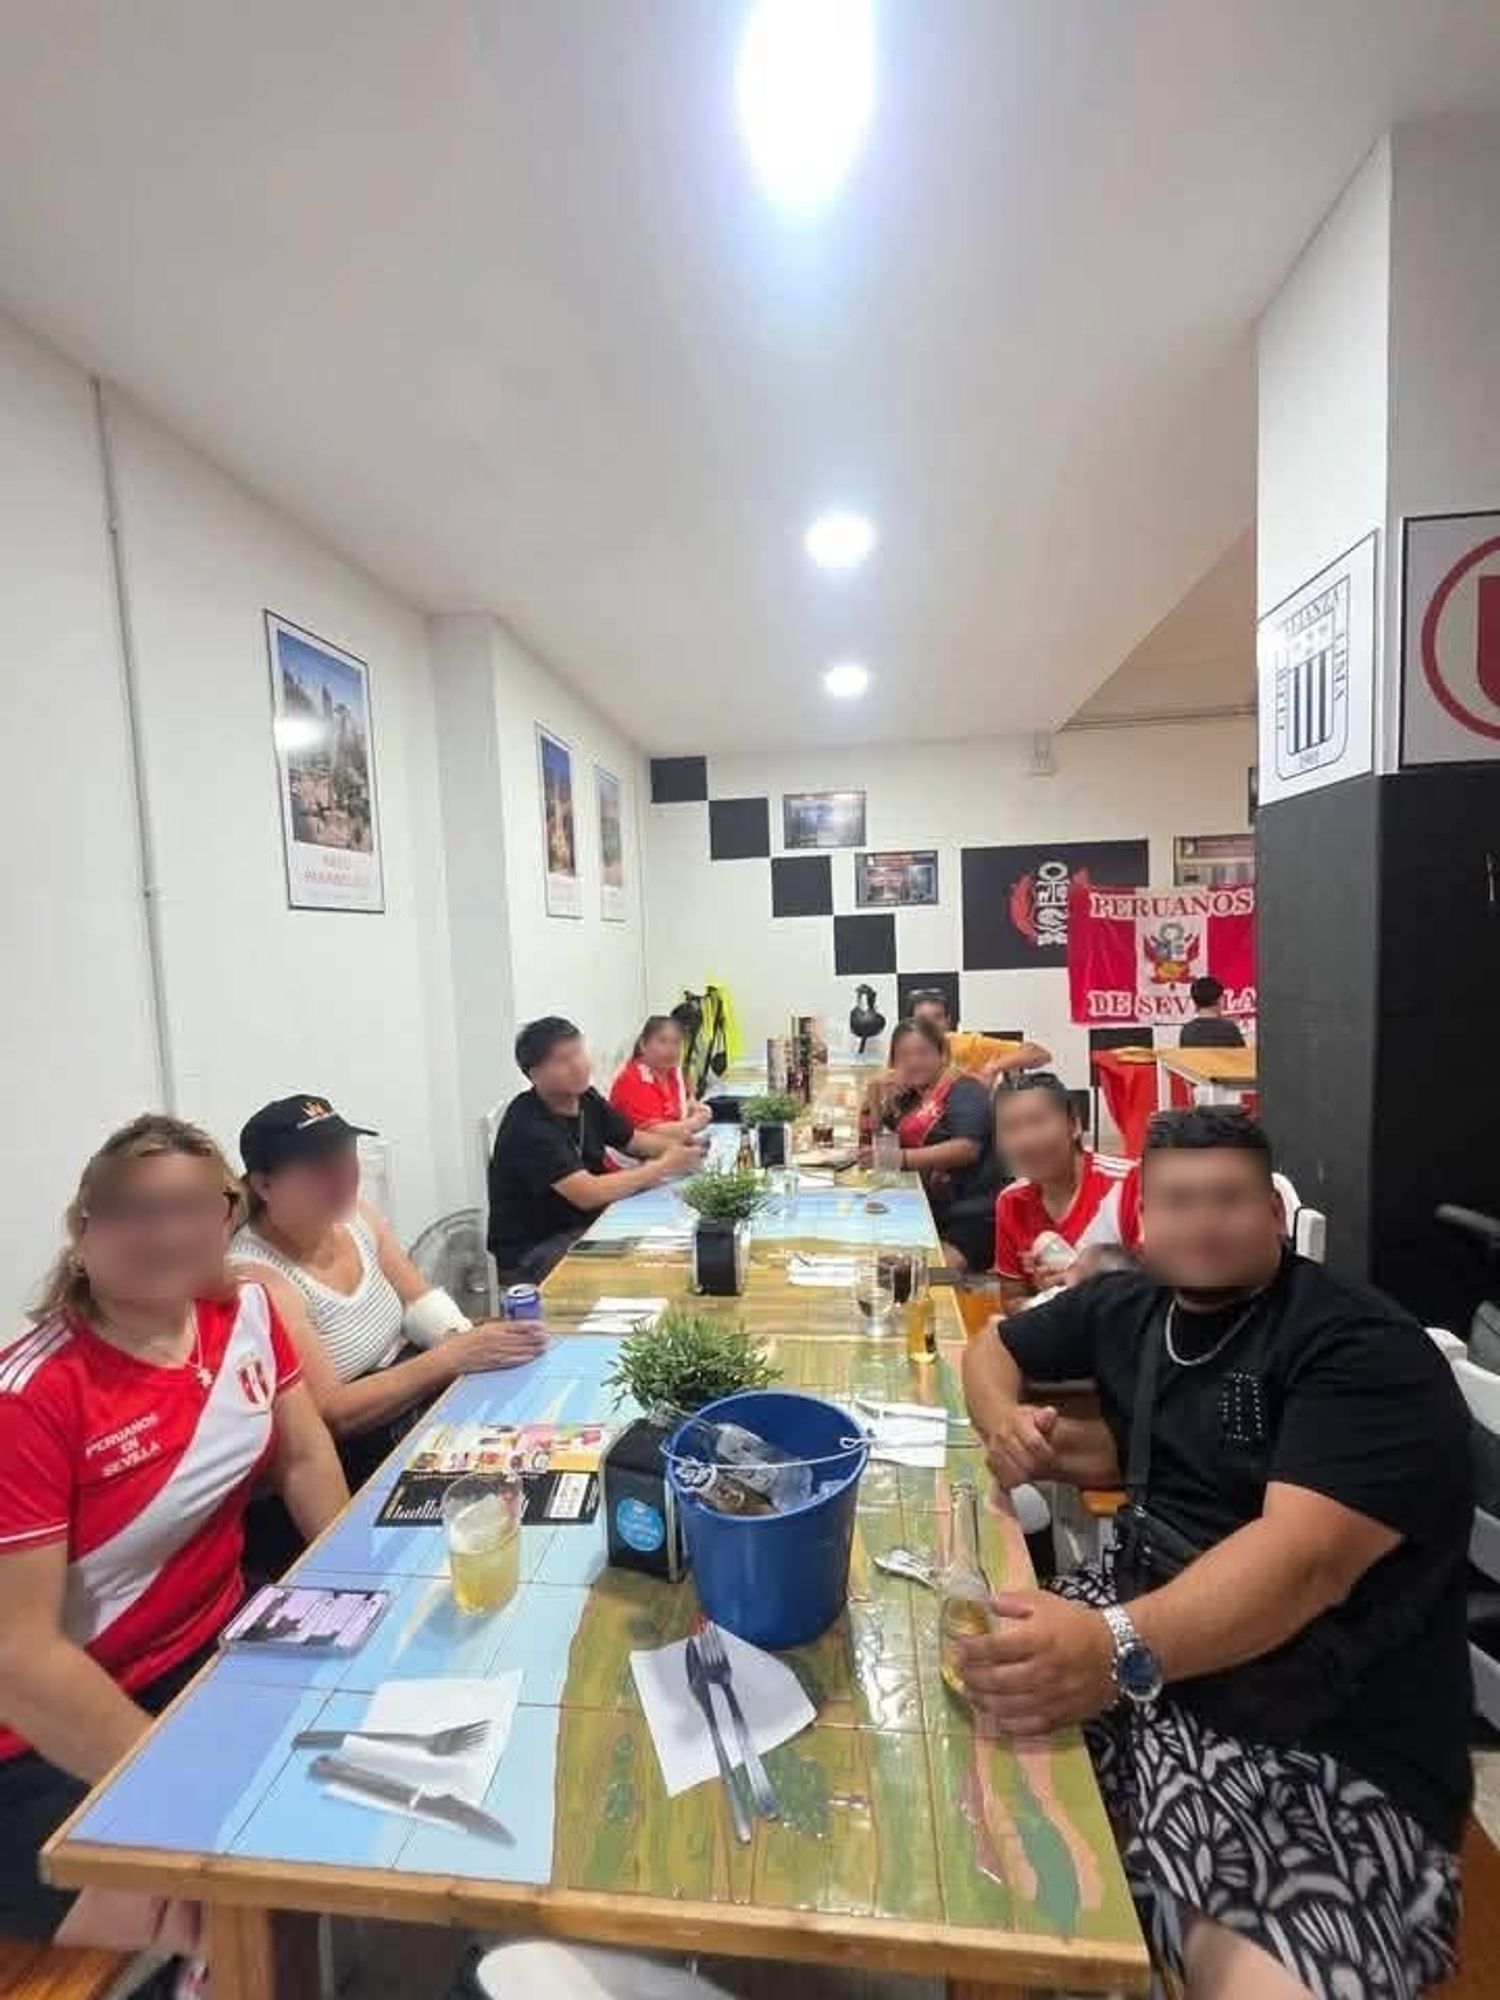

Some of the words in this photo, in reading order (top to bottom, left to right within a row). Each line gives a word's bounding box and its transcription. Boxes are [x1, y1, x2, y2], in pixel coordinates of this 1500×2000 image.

[1093, 891, 1253, 919] PERUANOS
[1092, 992, 1131, 1015] DE
[1136, 990, 1255, 1016] SEVLA
[103, 1441, 161, 1477] SEVILLA
